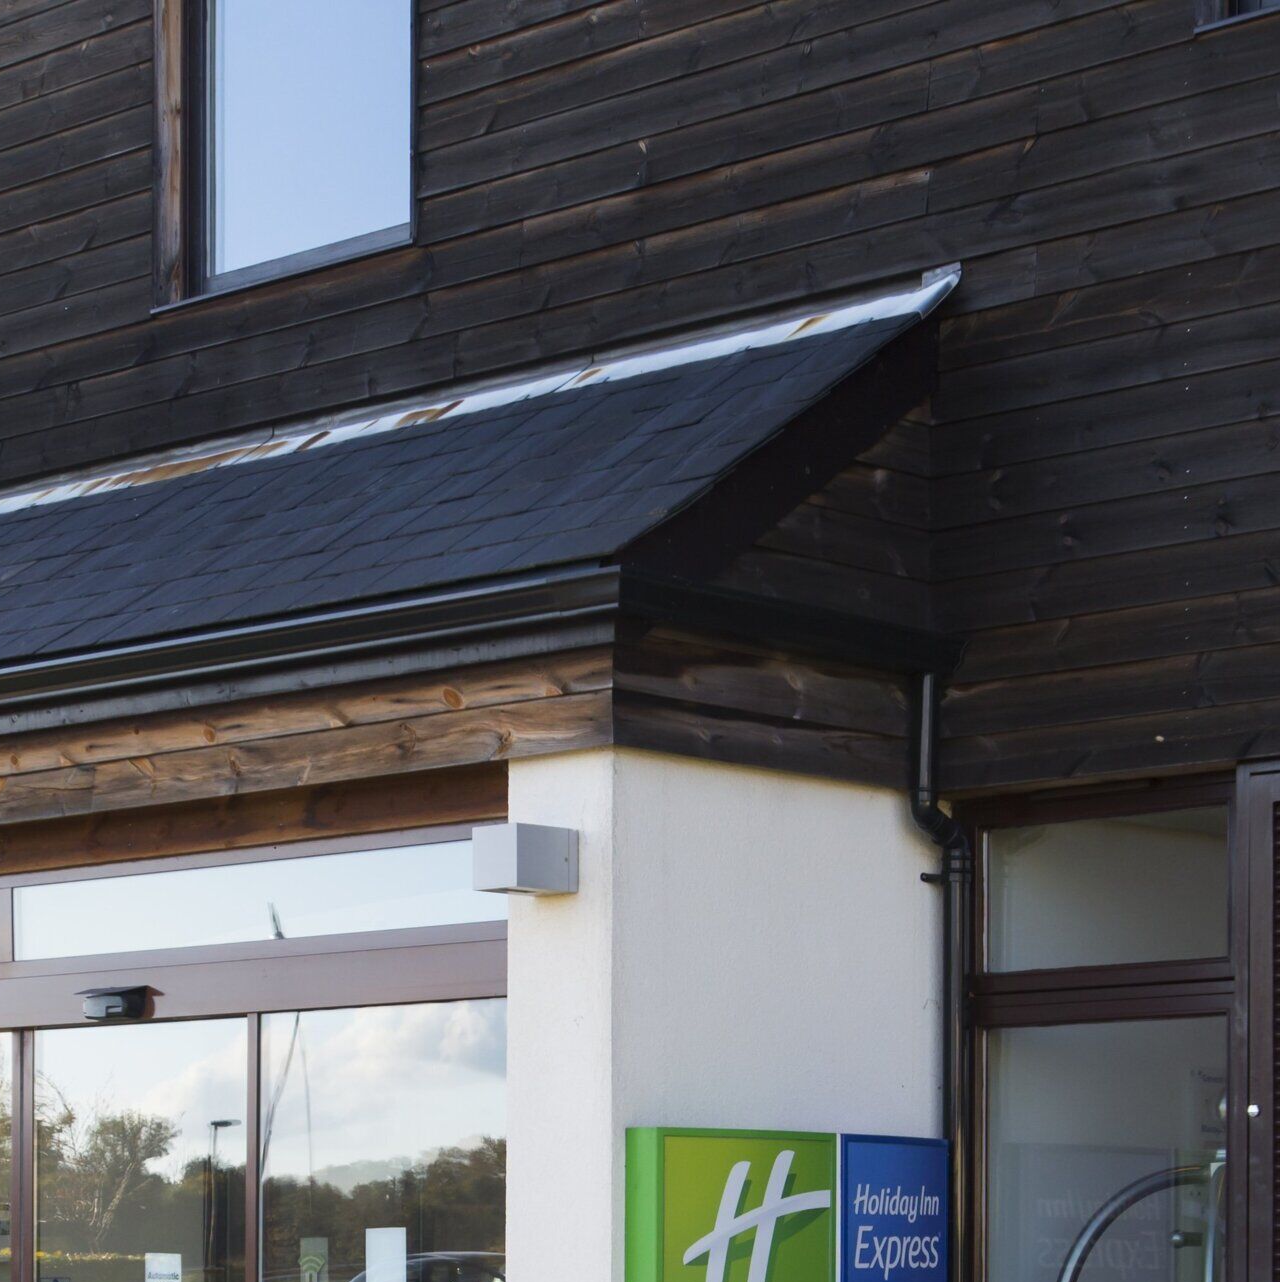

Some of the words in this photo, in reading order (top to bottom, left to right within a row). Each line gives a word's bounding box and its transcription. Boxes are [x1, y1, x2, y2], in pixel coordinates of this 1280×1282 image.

[853, 1184, 919, 1223] Holiday
[919, 1185, 940, 1216] Inn
[854, 1226, 940, 1281] Express
[147, 1271, 180, 1281] Automatic
